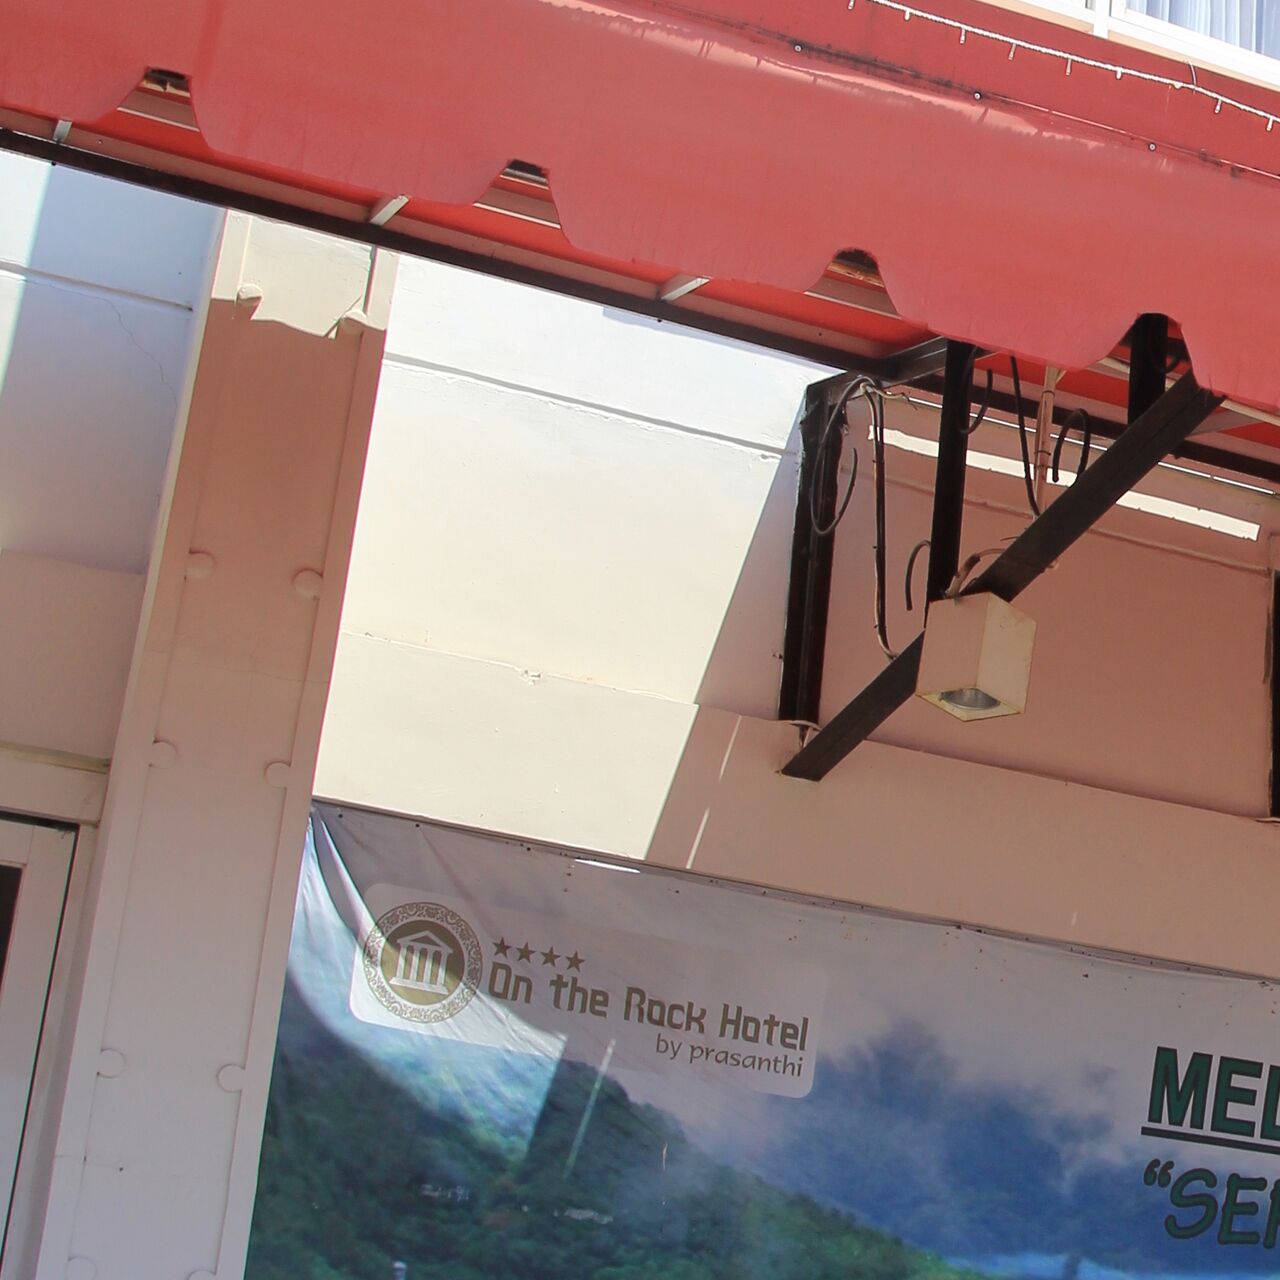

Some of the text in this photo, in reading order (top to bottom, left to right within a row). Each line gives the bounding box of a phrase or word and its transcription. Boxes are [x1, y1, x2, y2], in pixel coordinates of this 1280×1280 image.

[488, 961, 810, 1051] On the Rock Hotel
[655, 1033, 803, 1078] by prasanthi
